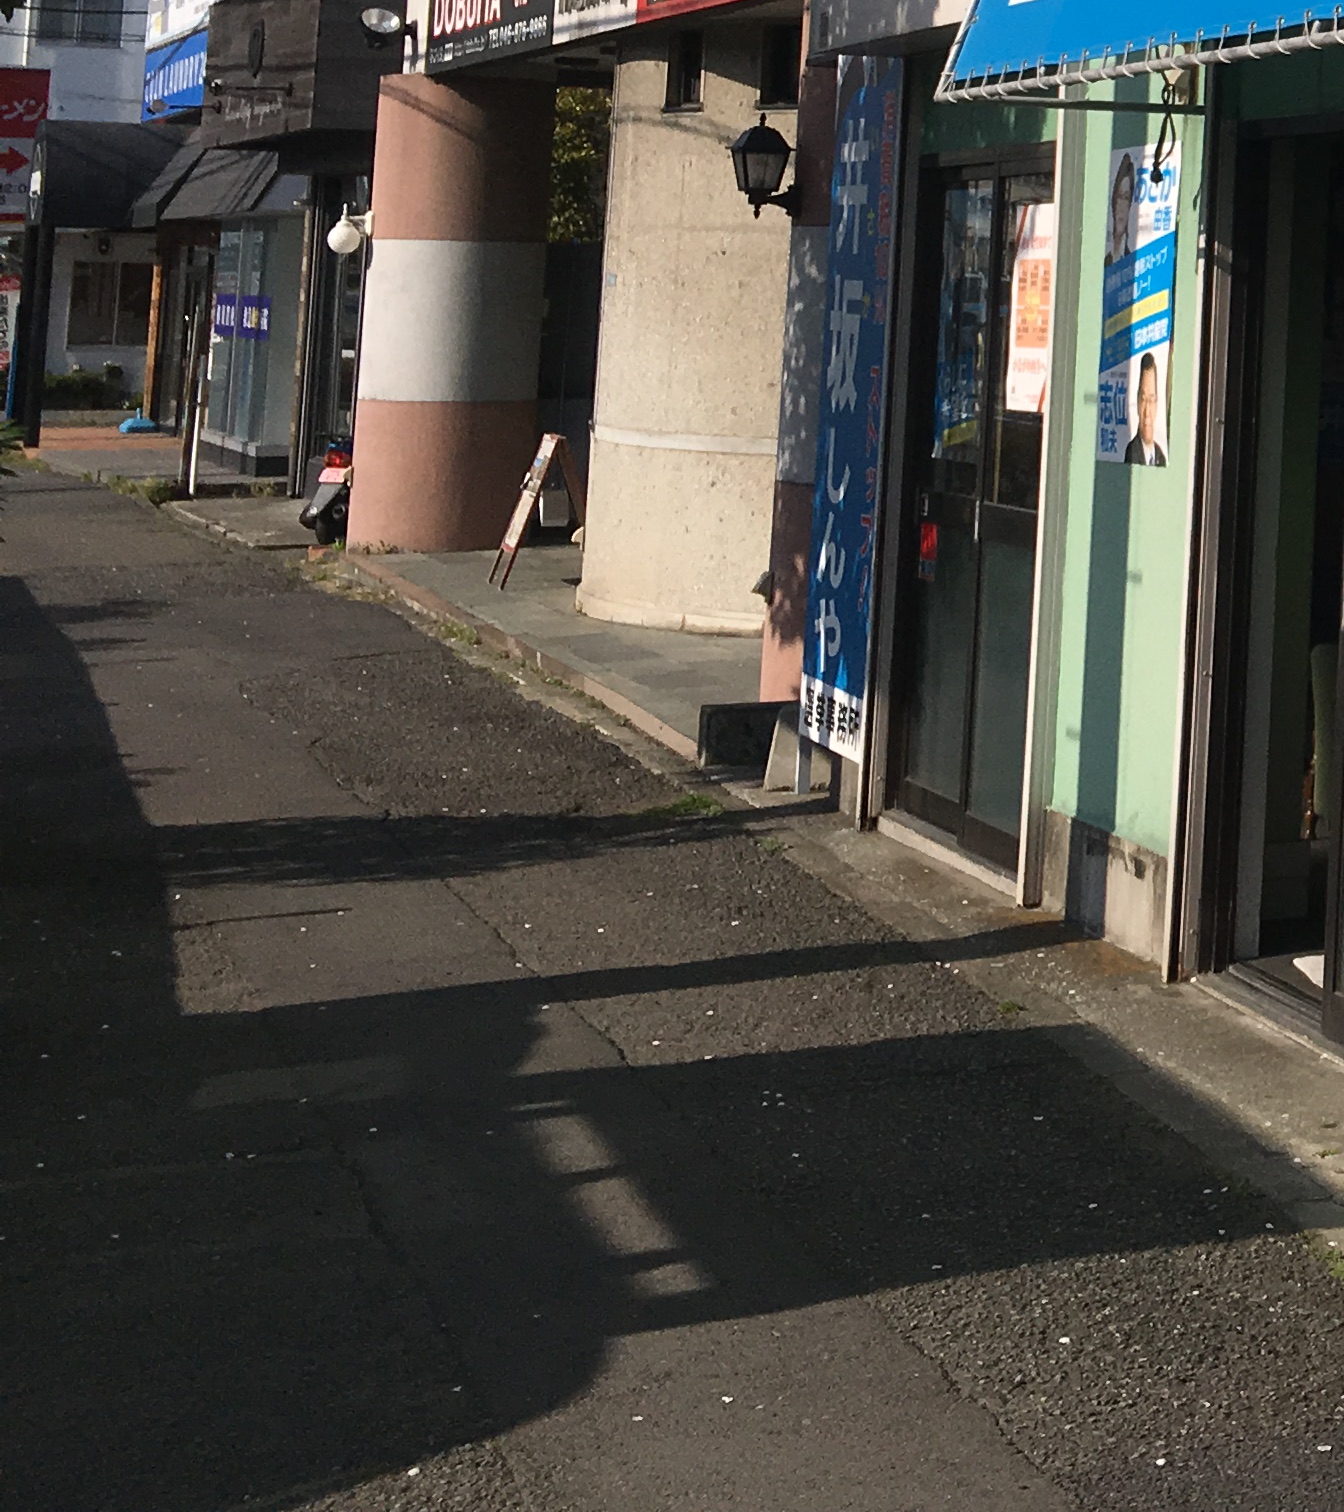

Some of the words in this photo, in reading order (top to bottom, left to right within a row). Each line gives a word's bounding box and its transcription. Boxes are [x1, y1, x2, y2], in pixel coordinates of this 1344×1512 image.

[815, 117, 870, 673] 井坂しんや
